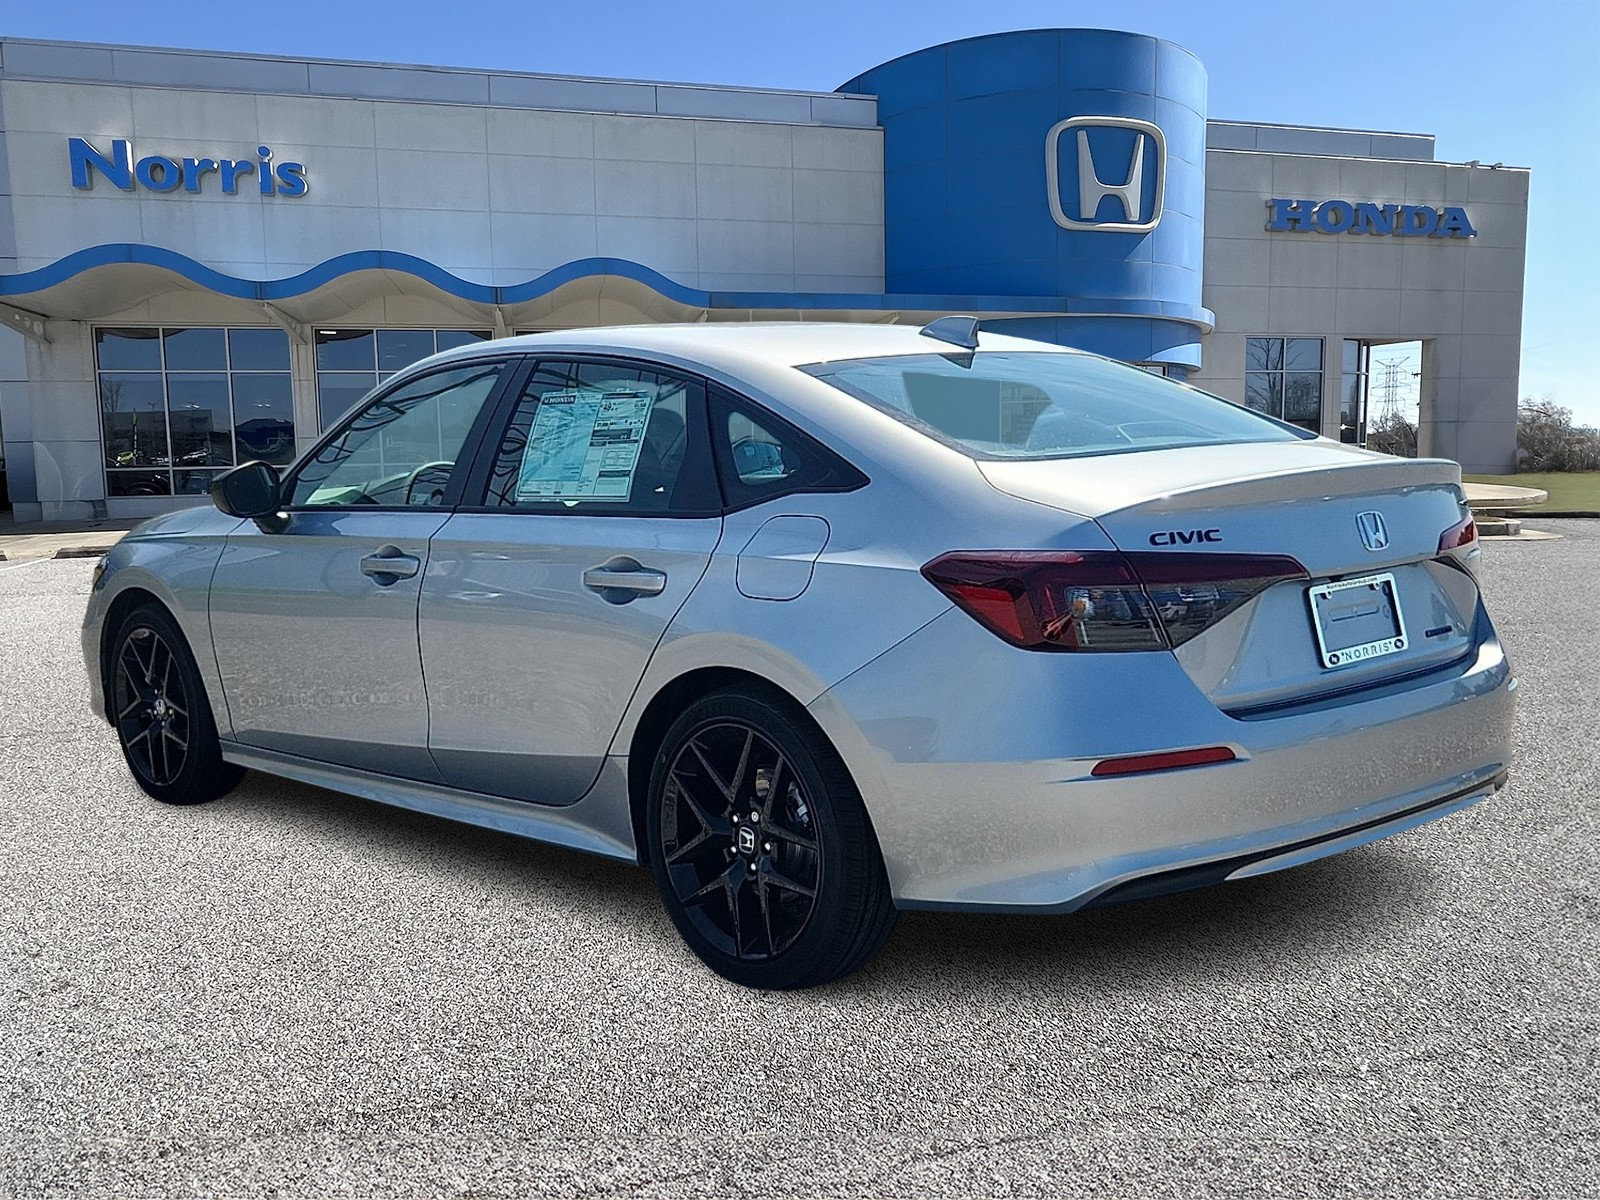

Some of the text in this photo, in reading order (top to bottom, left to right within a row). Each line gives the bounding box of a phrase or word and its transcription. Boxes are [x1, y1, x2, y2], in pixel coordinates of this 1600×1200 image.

[67, 137, 309, 197] Norris
[1265, 198, 1477, 239] HONDA
[549, 396, 574, 404] HONDA
[1149, 529, 1223, 546] CIVIC
